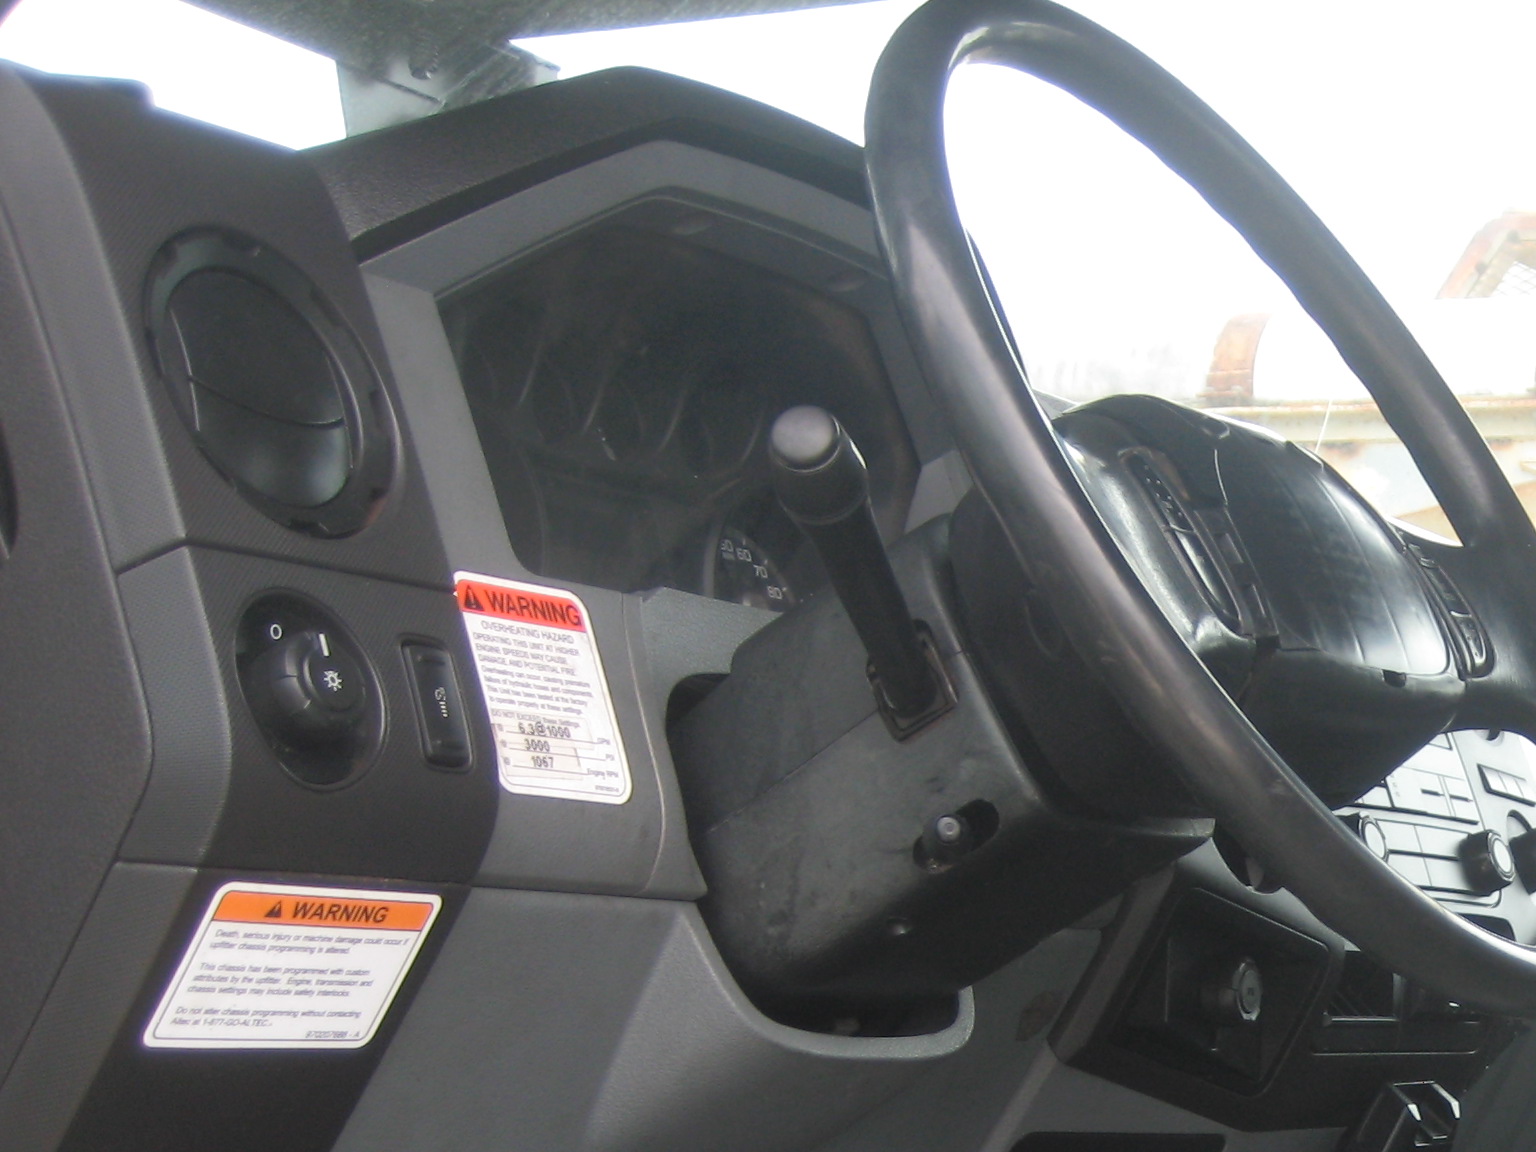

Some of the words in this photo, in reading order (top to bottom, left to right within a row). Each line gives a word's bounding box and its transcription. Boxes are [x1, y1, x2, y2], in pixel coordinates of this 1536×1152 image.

[753, 564, 768, 578] 70
[485, 589, 582, 627] WARNING
[481, 620, 540, 639] OVERHEATING
[541, 631, 575, 645] HAZARD
[473, 632, 512, 646] OPERATING
[513, 639, 528, 649] THIS
[475, 643, 502, 655] ENGINE
[502, 647, 530, 659] SPEEDS
[524, 738, 551, 753] 3000
[292, 901, 389, 924] WARNING
[242, 932, 271, 941] serious
[271, 933, 293, 942] injury
[238, 943, 268, 951] chassis
[267, 945, 317, 955] programming
[200, 962, 216, 972] This
[217, 964, 247, 973] chassis
[187, 985, 217, 994] chassis
[176, 1006, 189, 1015] Do
[188, 1007, 203, 1015] not
[220, 1008, 251, 1016] chassis
[250, 1009, 301, 1019] programming
